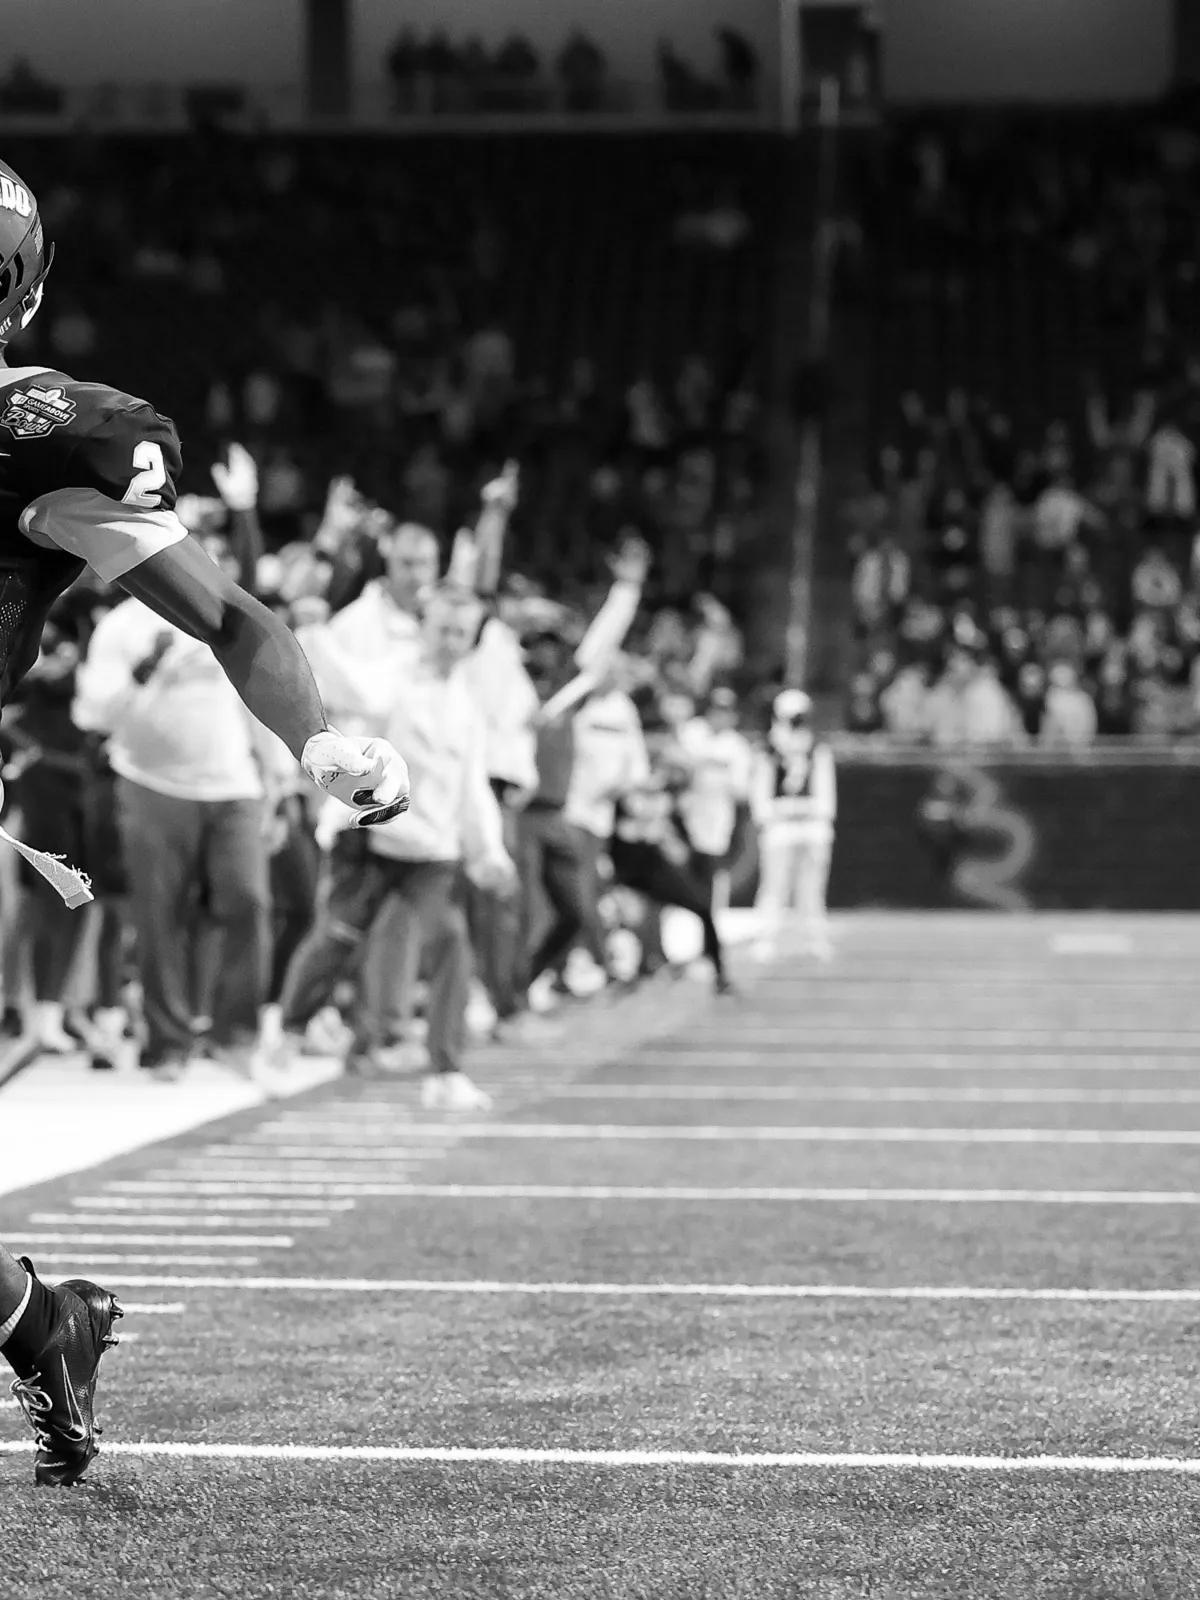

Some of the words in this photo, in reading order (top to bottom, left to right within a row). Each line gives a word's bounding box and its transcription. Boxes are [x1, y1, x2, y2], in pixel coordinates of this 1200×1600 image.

[27, 398, 70, 421] GAMEABOVE
[1, 410, 54, 434] Bowl
[120, 440, 167, 508] 2
